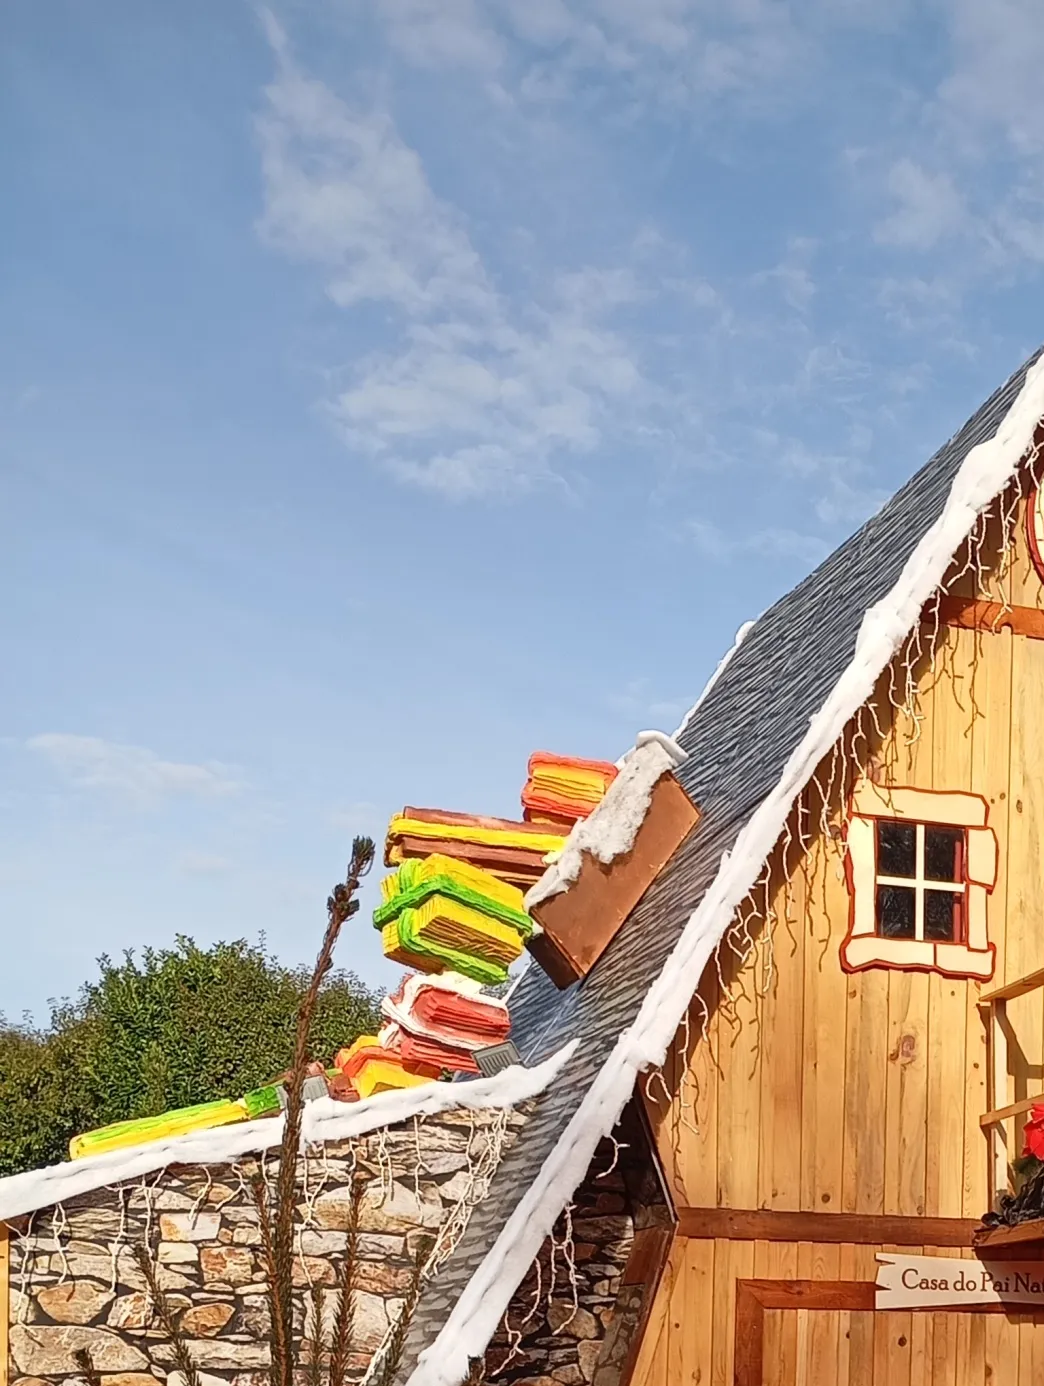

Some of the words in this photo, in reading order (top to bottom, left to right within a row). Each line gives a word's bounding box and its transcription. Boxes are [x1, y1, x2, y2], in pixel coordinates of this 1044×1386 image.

[901, 1268, 949, 1291] Casa
[953, 1271, 977, 1292] do
[980, 1271, 1010, 1293] Pai
